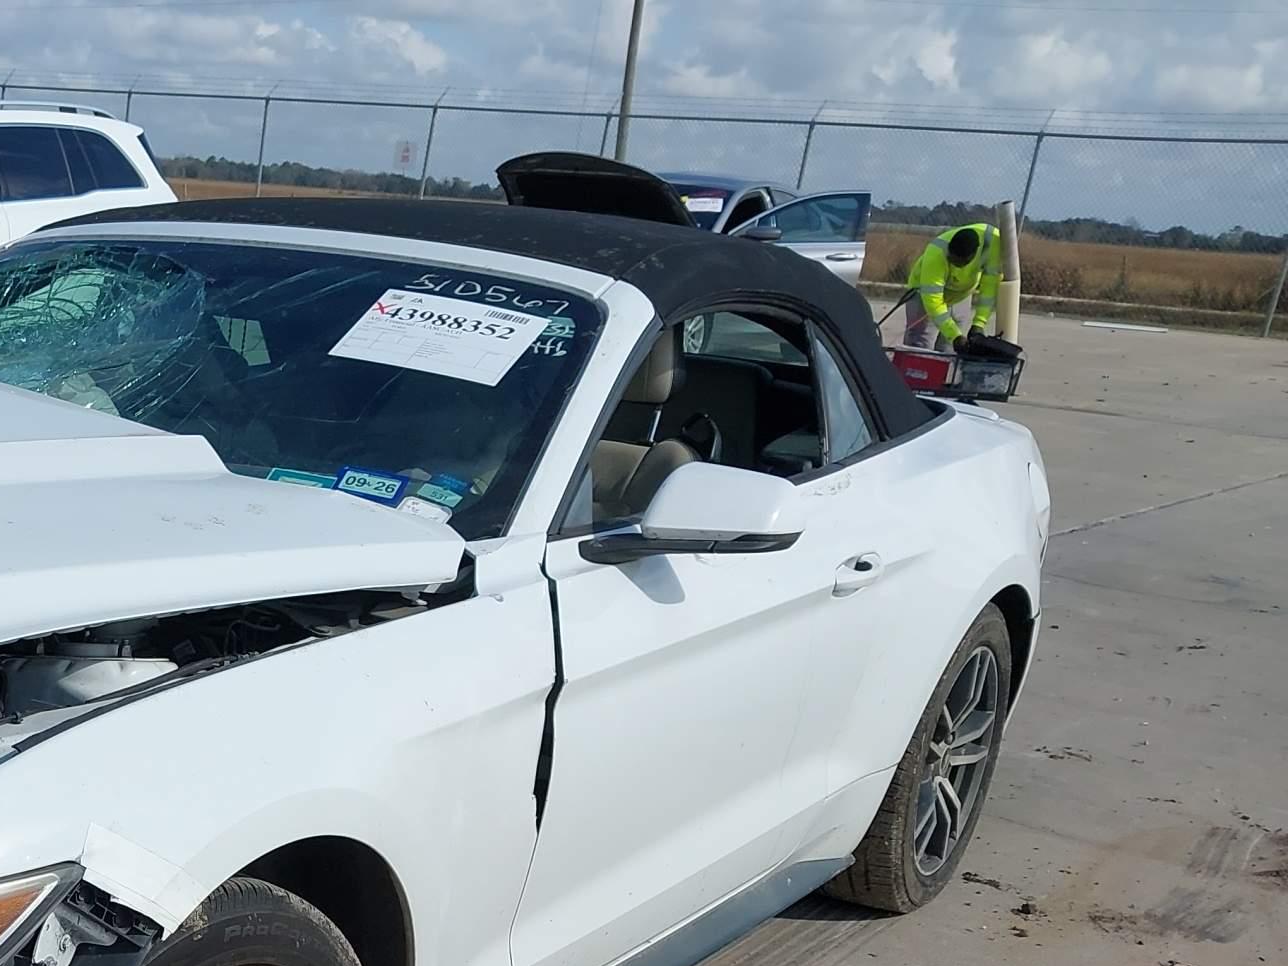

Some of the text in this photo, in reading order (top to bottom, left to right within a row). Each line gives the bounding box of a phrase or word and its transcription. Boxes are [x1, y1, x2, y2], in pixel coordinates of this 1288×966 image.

[385, 306, 516, 341] 43988352
[344, 475, 396, 494] 09 26
